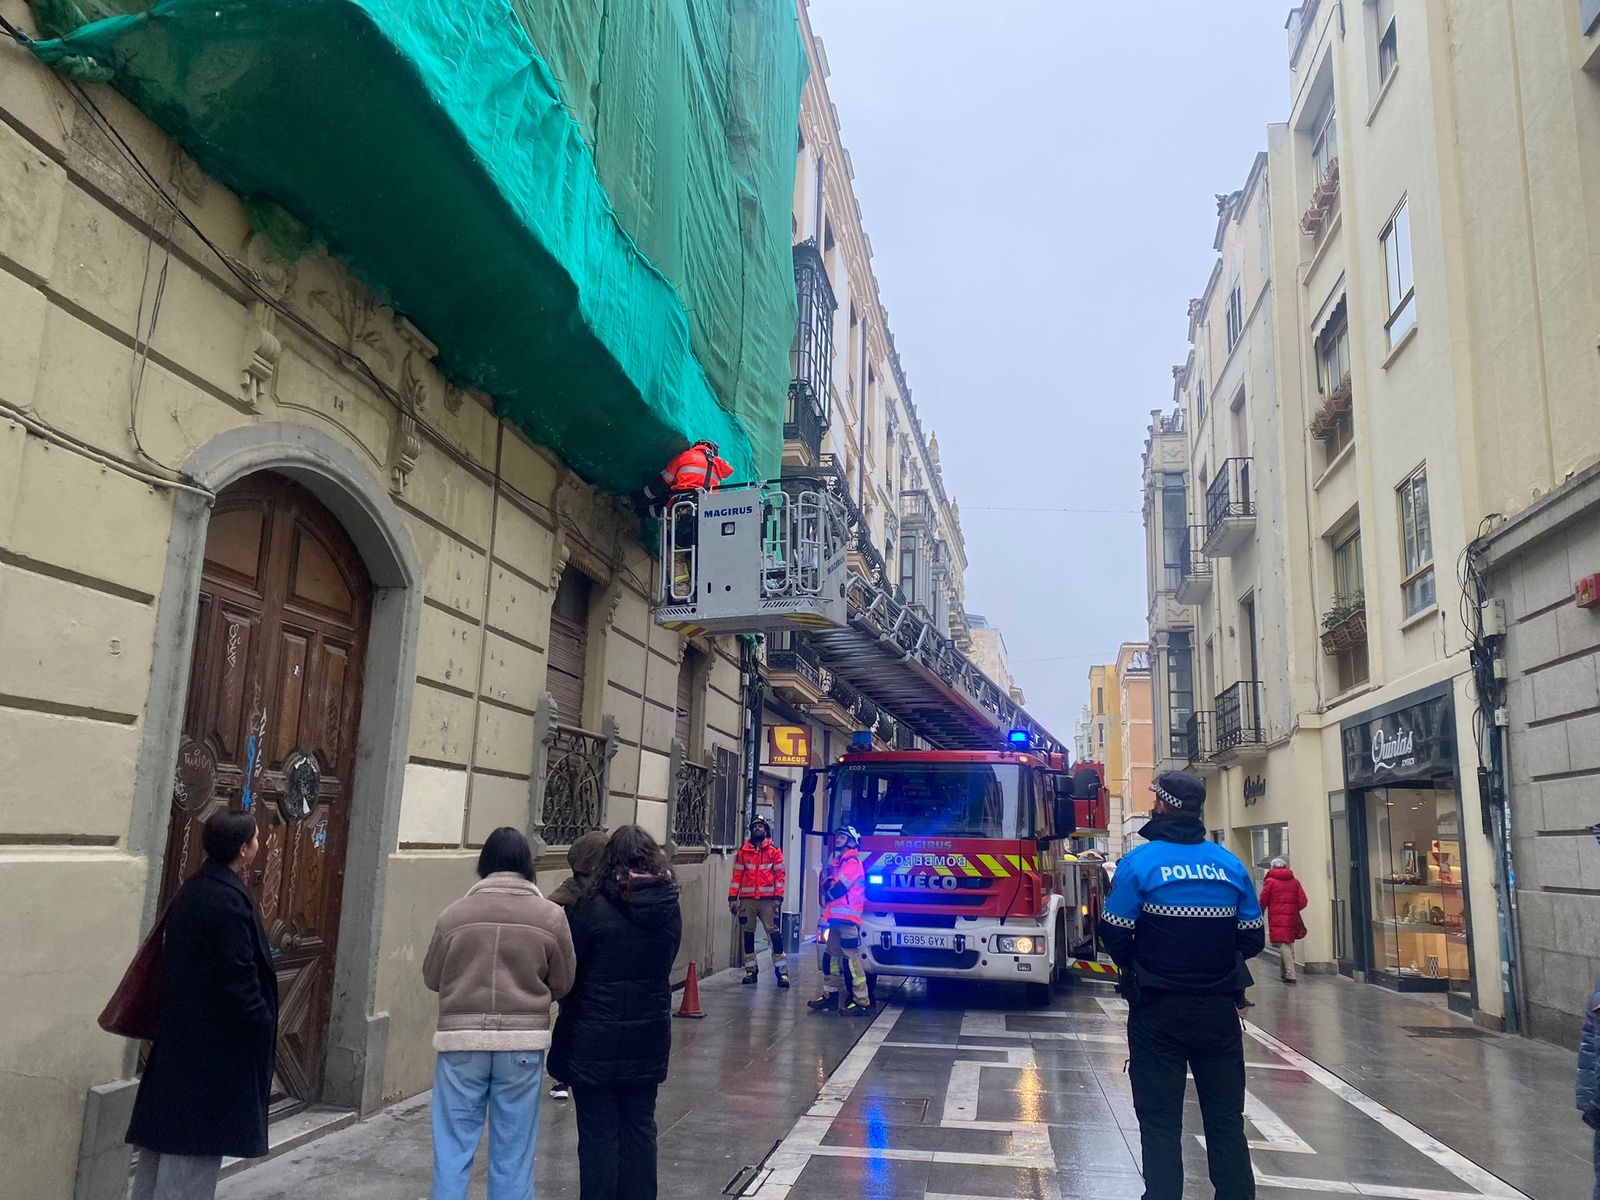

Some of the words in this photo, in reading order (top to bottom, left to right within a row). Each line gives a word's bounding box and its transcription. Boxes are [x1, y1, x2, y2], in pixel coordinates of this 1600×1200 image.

[333, 395, 344, 412] 14
[704, 506, 753, 518] MAGIRUS
[1371, 727, 1414, 773] Quintas
[894, 840, 953, 850] MAGIRUS
[890, 875, 957, 891] IVECO
[903, 935, 926, 945] 6395
[928, 936, 946, 947] GYX
